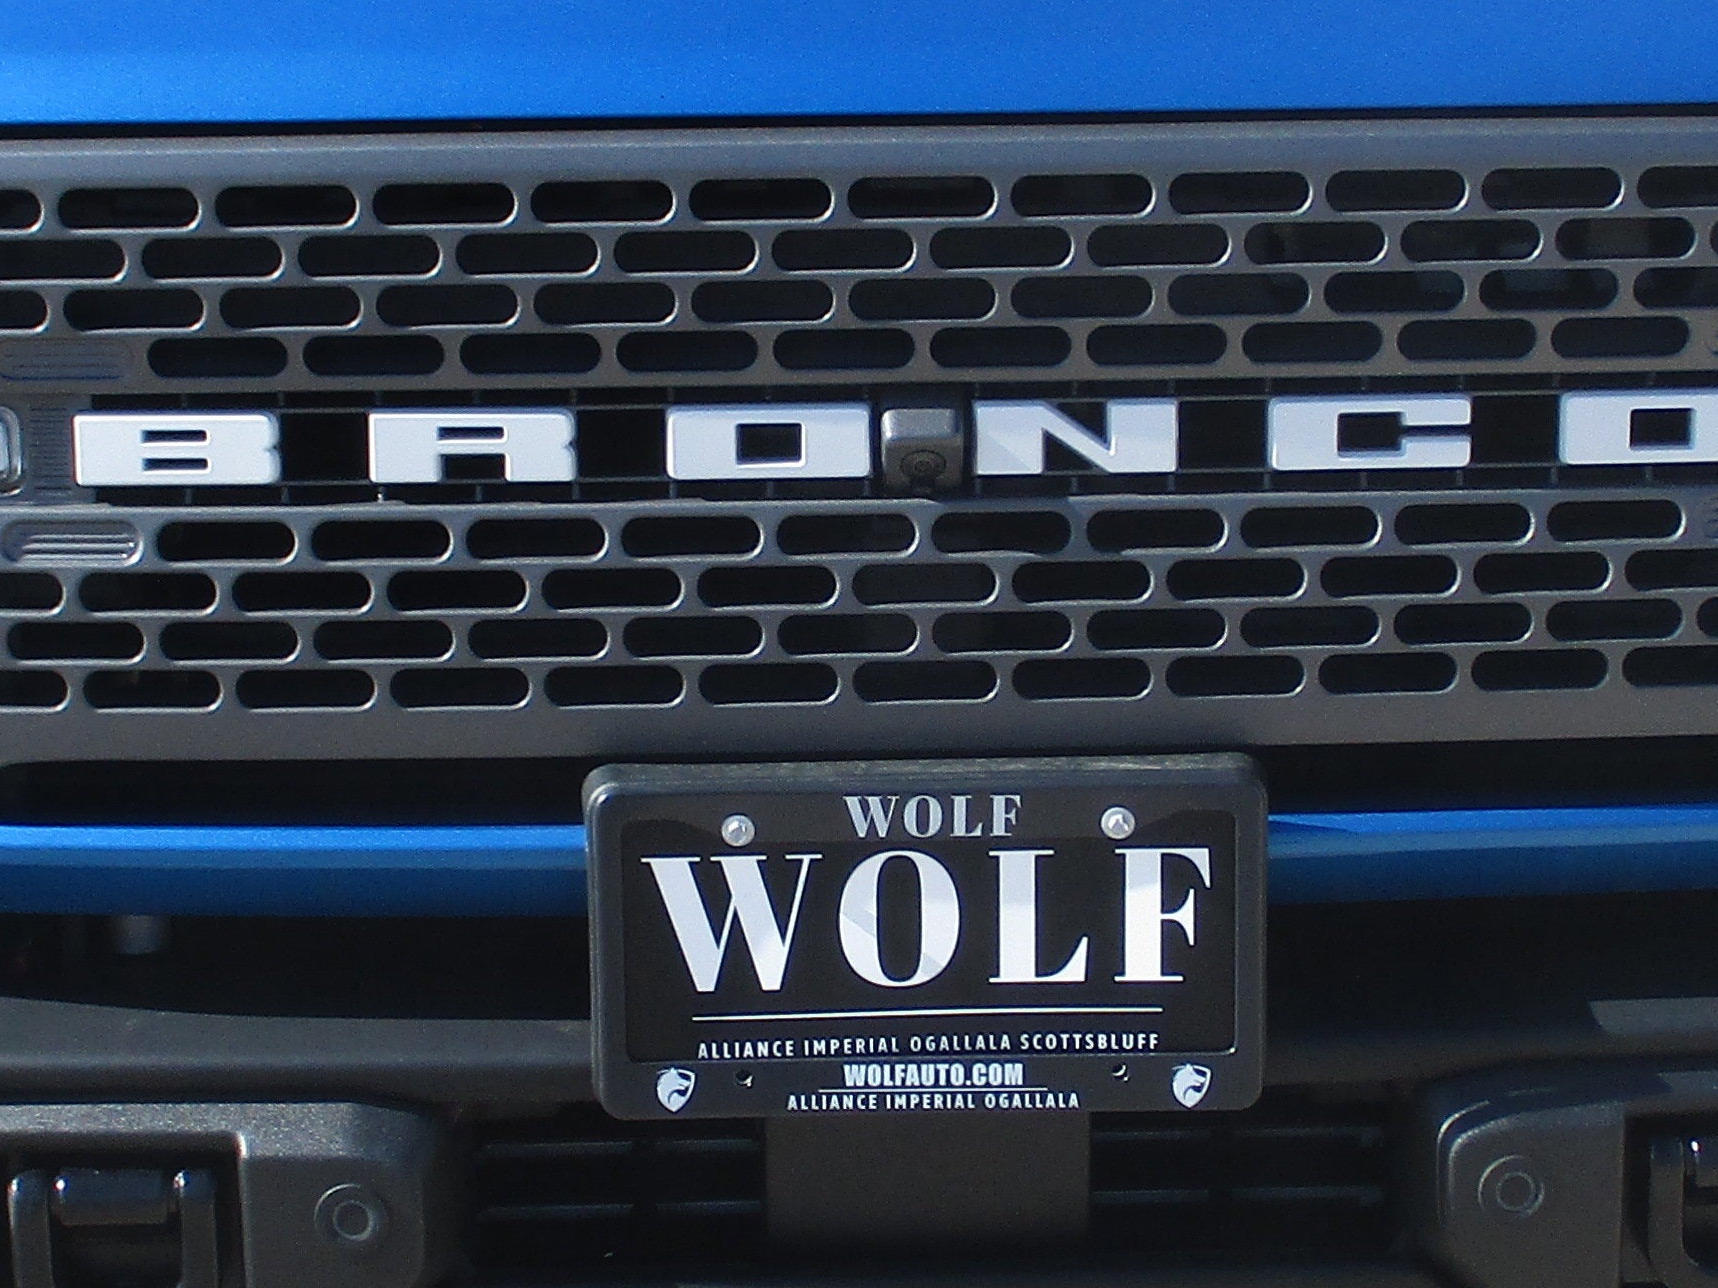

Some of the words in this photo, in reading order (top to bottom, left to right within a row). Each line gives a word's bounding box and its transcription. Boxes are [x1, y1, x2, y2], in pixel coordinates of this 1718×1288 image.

[843, 794, 1021, 838] WOLF
[640, 847, 1211, 993] WOLF
[697, 1040, 795, 1060] ALLIANCE
[804, 1037, 900, 1055] IMPERIAL
[910, 1034, 1011, 1052] OGALLALA
[1020, 1032, 1160, 1051] SCOTTSBLUFF
[843, 1062, 1024, 1088] WOLFAUTO.COM
[786, 1094, 878, 1111] ALLIANCE
[885, 1093, 975, 1110] IMPERIAL
[984, 1092, 1080, 1110] OGALLALA
